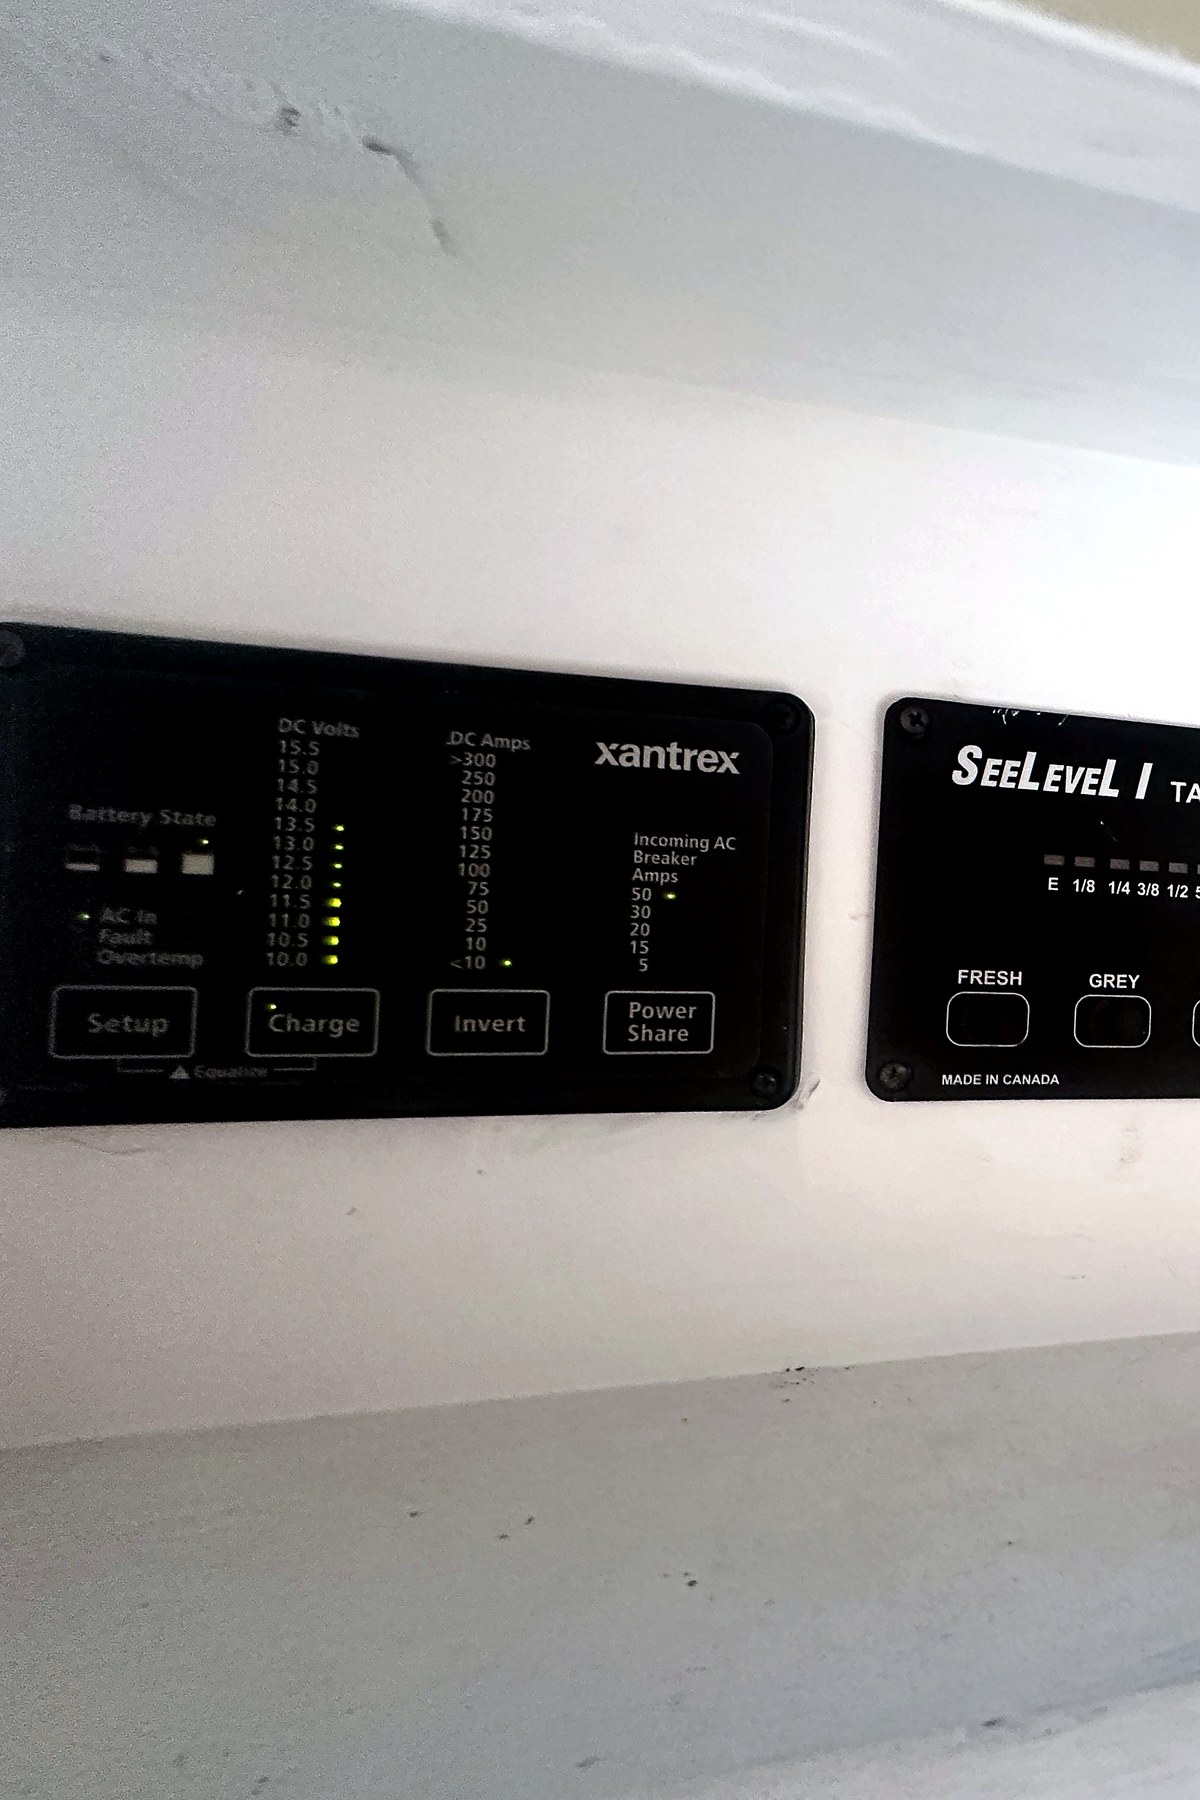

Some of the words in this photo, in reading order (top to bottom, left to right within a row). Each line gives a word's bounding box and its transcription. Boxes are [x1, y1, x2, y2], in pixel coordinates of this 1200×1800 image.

[278, 716, 307, 736] DC
[312, 720, 360, 740] Volts
[277, 740, 321, 756] 15.5
[449, 730, 477, 747] DC
[480, 735, 532, 753] Amps
[594, 740, 741, 775] xantrex
[276, 759, 320, 776] 15.0
[275, 778, 319, 795] 14.5
[461, 770, 496, 787] 250
[274, 797, 318, 814] 14.0
[460, 789, 496, 805] 200
[66, 803, 153, 828] Battery
[158, 808, 217, 828] State
[461, 807, 494, 823] 175
[273, 816, 317, 833] 13.5
[460, 825, 494, 842] 150
[272, 835, 316, 852] 13.0
[633, 832, 710, 853] Incoming
[713, 836, 737, 852] AC
[459, 843, 492, 860] 125
[633, 850, 698, 867] Breaker
[271, 854, 314, 871] 12.5
[458, 861, 492, 878] 100
[270, 873, 313, 891] 12.0
[632, 868, 679, 885] Amps
[468, 880, 490, 897] 75
[631, 886, 653, 902] 50
[1047, 877, 1059, 893] E
[1072, 877, 1096, 895] 1/8
[1107, 880, 1131, 898] 1/4
[1137, 882, 1160, 899] 3/8
[1166, 883, 1189, 900] 1/2
[269, 893, 312, 910] 11.5
[466, 899, 489, 915] 50
[268, 912, 311, 929] 11.0
[630, 904, 652, 920] 30
[466, 918, 488, 934] 25
[629, 922, 651, 938] 20
[266, 931, 310, 949] 10.5
[465, 936, 487, 953] 10
[630, 940, 650, 955] 15
[265, 950, 309, 968] 10.0
[638, 957, 649, 973] 5
[957, 968, 1023, 987] FRESH
[1088, 972, 1140, 990] GREY
[628, 1000, 698, 1021] Power
[86, 1012, 172, 1037] Setup
[266, 1012, 362, 1038] Charge
[454, 1014, 526, 1034] Invert
[627, 1023, 690, 1044] Share
[941, 1073, 981, 1087] MADE
[984, 1073, 999, 1087] IN
[1002, 1073, 1060, 1087] CANADA
